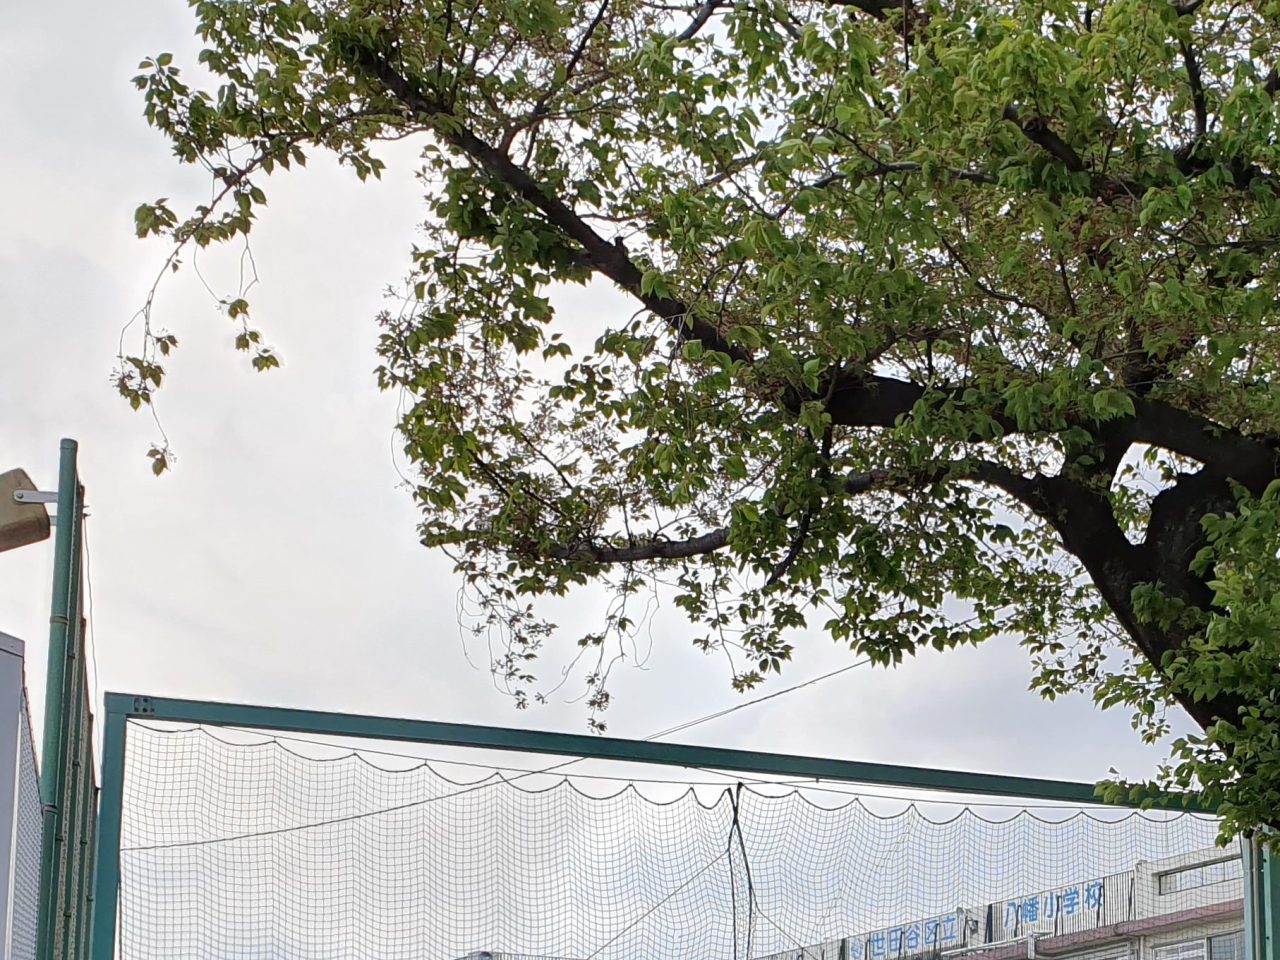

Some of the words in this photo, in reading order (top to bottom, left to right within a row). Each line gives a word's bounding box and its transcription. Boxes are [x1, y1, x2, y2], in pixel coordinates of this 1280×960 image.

[1004, 881, 1104, 928] 八幡小学校
[870, 916, 957, 957] 世田谷区立
